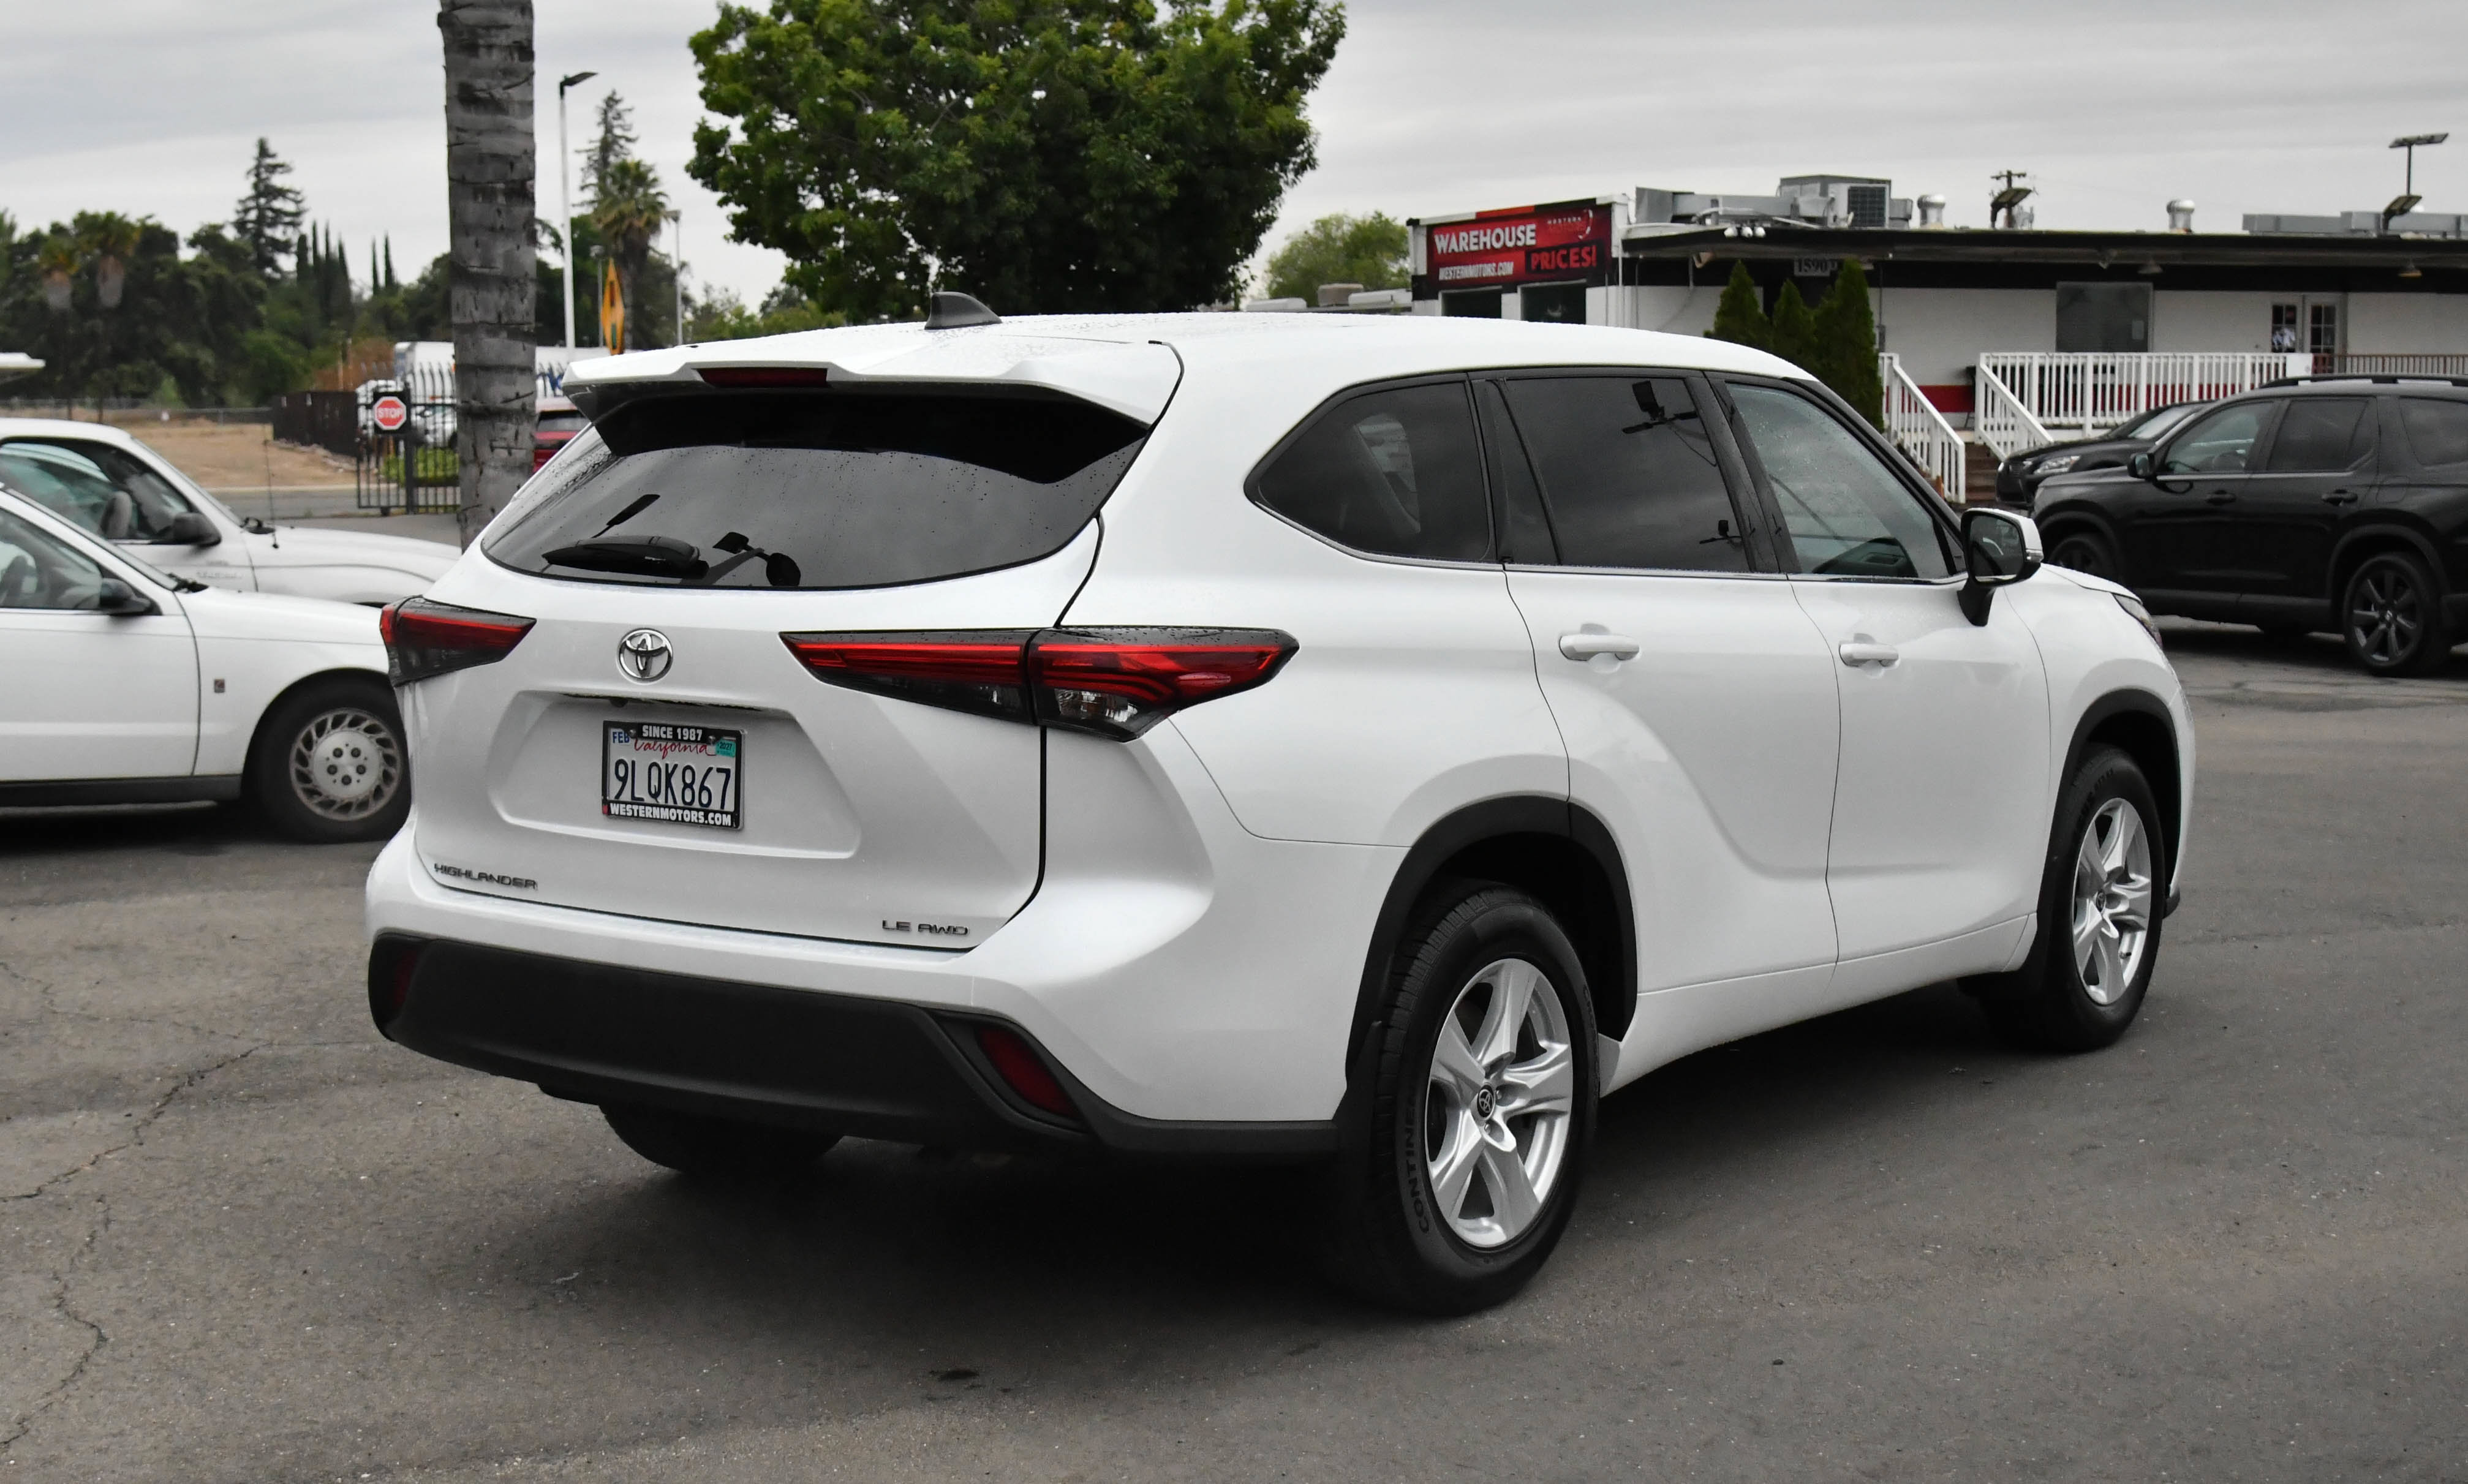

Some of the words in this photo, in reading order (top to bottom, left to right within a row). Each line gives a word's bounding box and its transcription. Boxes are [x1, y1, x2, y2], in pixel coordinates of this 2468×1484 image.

[1434, 224, 1536, 254] WAREHOUSE
[1531, 245, 1596, 270] PRICES!
[1439, 262, 1514, 281] WESTERNMOTORS.COM
[377, 407, 403, 418] STOP
[613, 731, 630, 744] FEB
[642, 725, 673, 739] SINCE
[677, 728, 703, 740] 1987
[634, 737, 717, 759] California
[614, 758, 731, 810] 9LQK867
[610, 803, 731, 826] WESTERNMOTORS.COM
[434, 863, 538, 890] HIGHLANDER
[882, 919, 911, 931] LE
[918, 923, 969, 935] AWD
